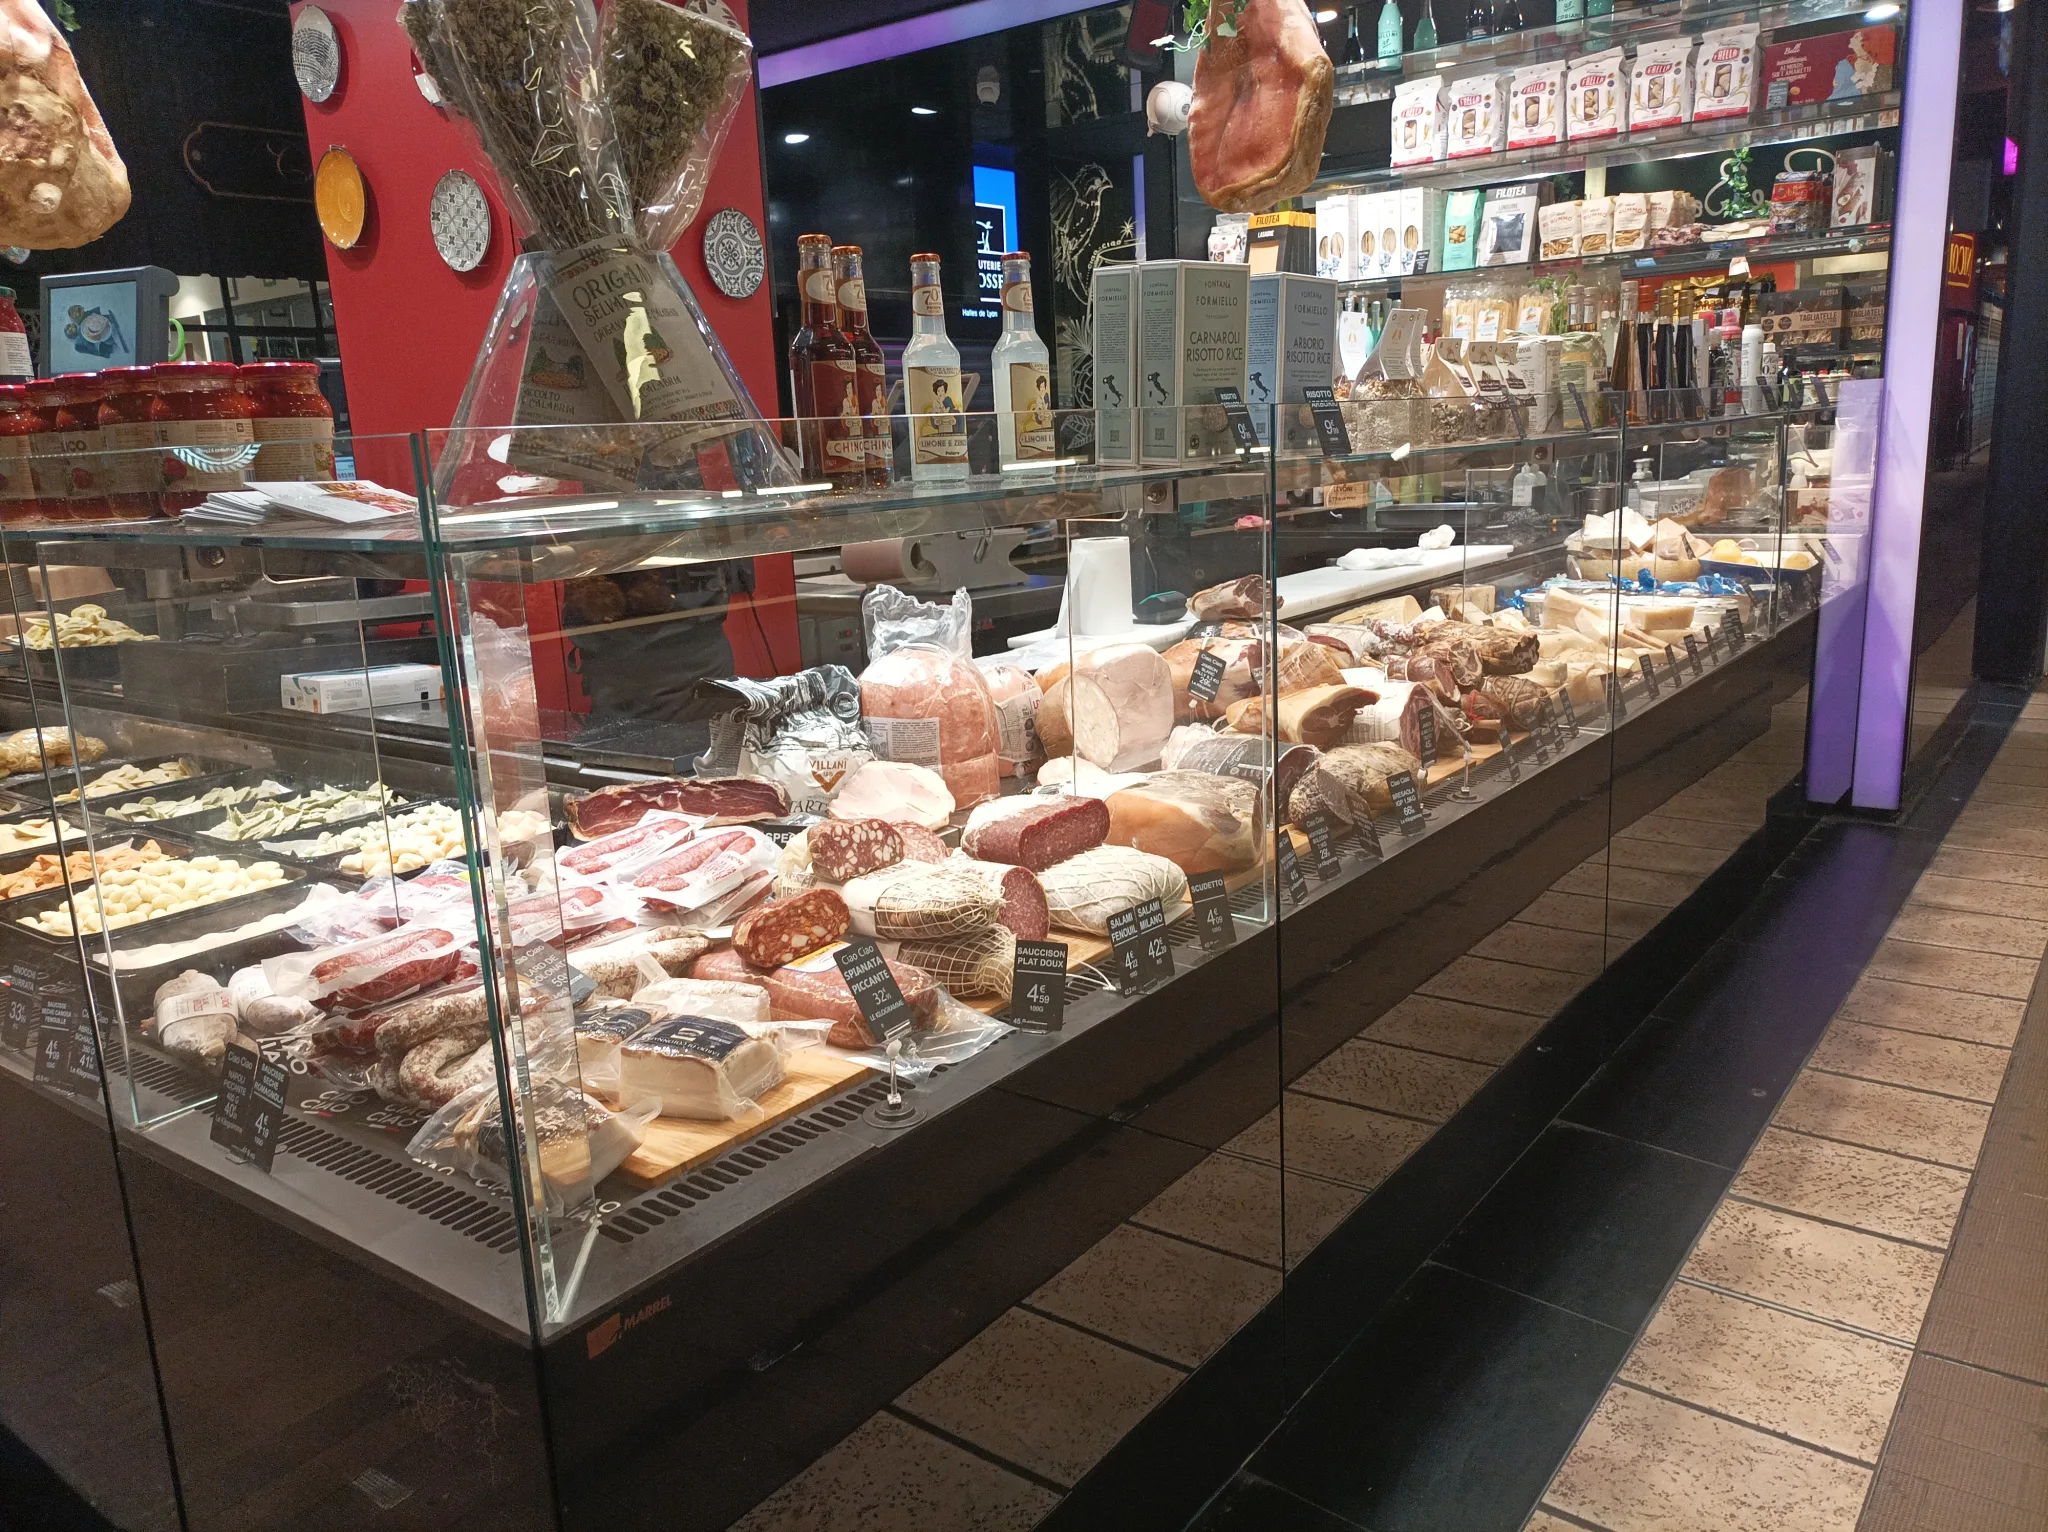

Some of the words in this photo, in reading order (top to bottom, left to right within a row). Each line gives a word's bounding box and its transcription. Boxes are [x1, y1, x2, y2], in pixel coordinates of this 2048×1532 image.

[1495, 186, 1527, 199] FILOTEA
[1256, 214, 1280, 226] FILOTEA
[1205, 280, 1231, 289] FONTANA
[1195, 297, 1238, 307] FORMIELLO
[1301, 291, 1323, 299] FONTANA
[962, 308, 978, 318] Halles
[978, 310, 986, 318] de
[986, 309, 998, 319] Lyon
[1294, 304, 1328, 316] FORMIELLO
[1799, 310, 1838, 322] TAGLIATELLE
[1189, 331, 1241, 345] CARNAROLI
[1293, 337, 1325, 350] ARBORIO
[1186, 347, 1224, 362] RISOTTO
[1225, 347, 1243, 361] RICE
[1286, 350, 1315, 364] RISOTTO
[1317, 352, 1331, 365] RICE
[1305, 389, 1332, 398] RISOTTO
[920, 439, 945, 448] LIMONE
[809, 760, 847, 770] VILLANI
[1191, 878, 1223, 894] SCUDETTO
[1137, 900, 1161, 918] SALAMI
[1110, 912, 1133, 930] SALAMI
[1139, 913, 1163, 931] MILANO
[1111, 925, 1138, 943] FENOUIL
[526, 945, 545, 957] Ciao
[842, 952, 858, 966] Ciao
[857, 945, 875, 957] Ciao
[1017, 946, 1066, 958] SAUCCISON
[523, 962, 547, 977] LARD
[544, 954, 559, 964] DE
[843, 955, 883, 982] SPIANATA
[1017, 957, 1039, 966] PLAT
[1040, 958, 1064, 968] DOUX
[13, 964, 36, 978] GNOCCHI
[12, 977, 34, 992] BURRATA
[851, 969, 890, 995] PICCANTE
[1026, 983, 1050, 1004] 4€59
[869, 1014, 876, 1022] LE
[875, 999, 905, 1020] KILOGRAMME
[228, 1051, 240, 1064] Ciao
[240, 1057, 253, 1070] Ciao
[228, 1070, 246, 1084] NAPOLI
[262, 1063, 285, 1082] SAUCISSE
[223, 1079, 247, 1096] PICCANTE
[263, 1075, 279, 1091] SECHE
[254, 1081, 284, 1106] ROMAGNOLA
[300, 1098, 350, 1113] CIAO
[366, 1111, 418, 1127] CIAO
